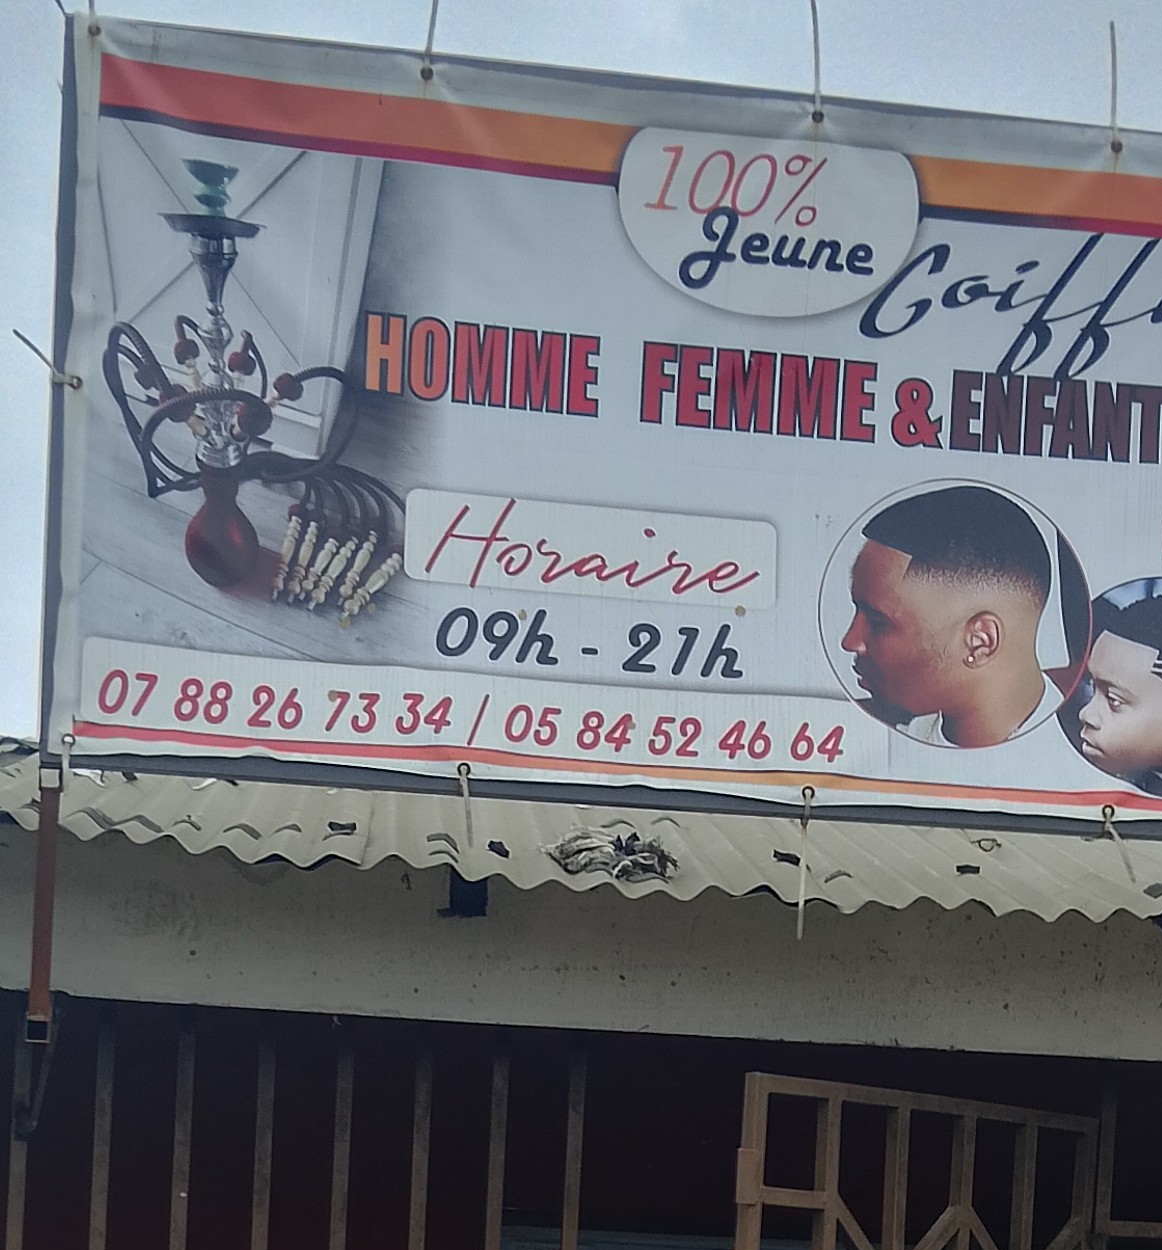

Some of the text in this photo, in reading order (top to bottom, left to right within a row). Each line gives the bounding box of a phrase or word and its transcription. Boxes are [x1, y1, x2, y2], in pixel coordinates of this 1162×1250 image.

[643, 144, 829, 228] 100%
[679, 206, 875, 290] Jeune
[365, 311, 600, 416] HOMME
[640, 340, 878, 447] FEMME
[891, 377, 944, 450] &
[425, 497, 761, 595] Horaire
[435, 606, 560, 668] 09h
[622, 622, 744, 680] 21h
[98, 669, 845, 765] 07 88 26 73 34 / 05 84 52 46 64
